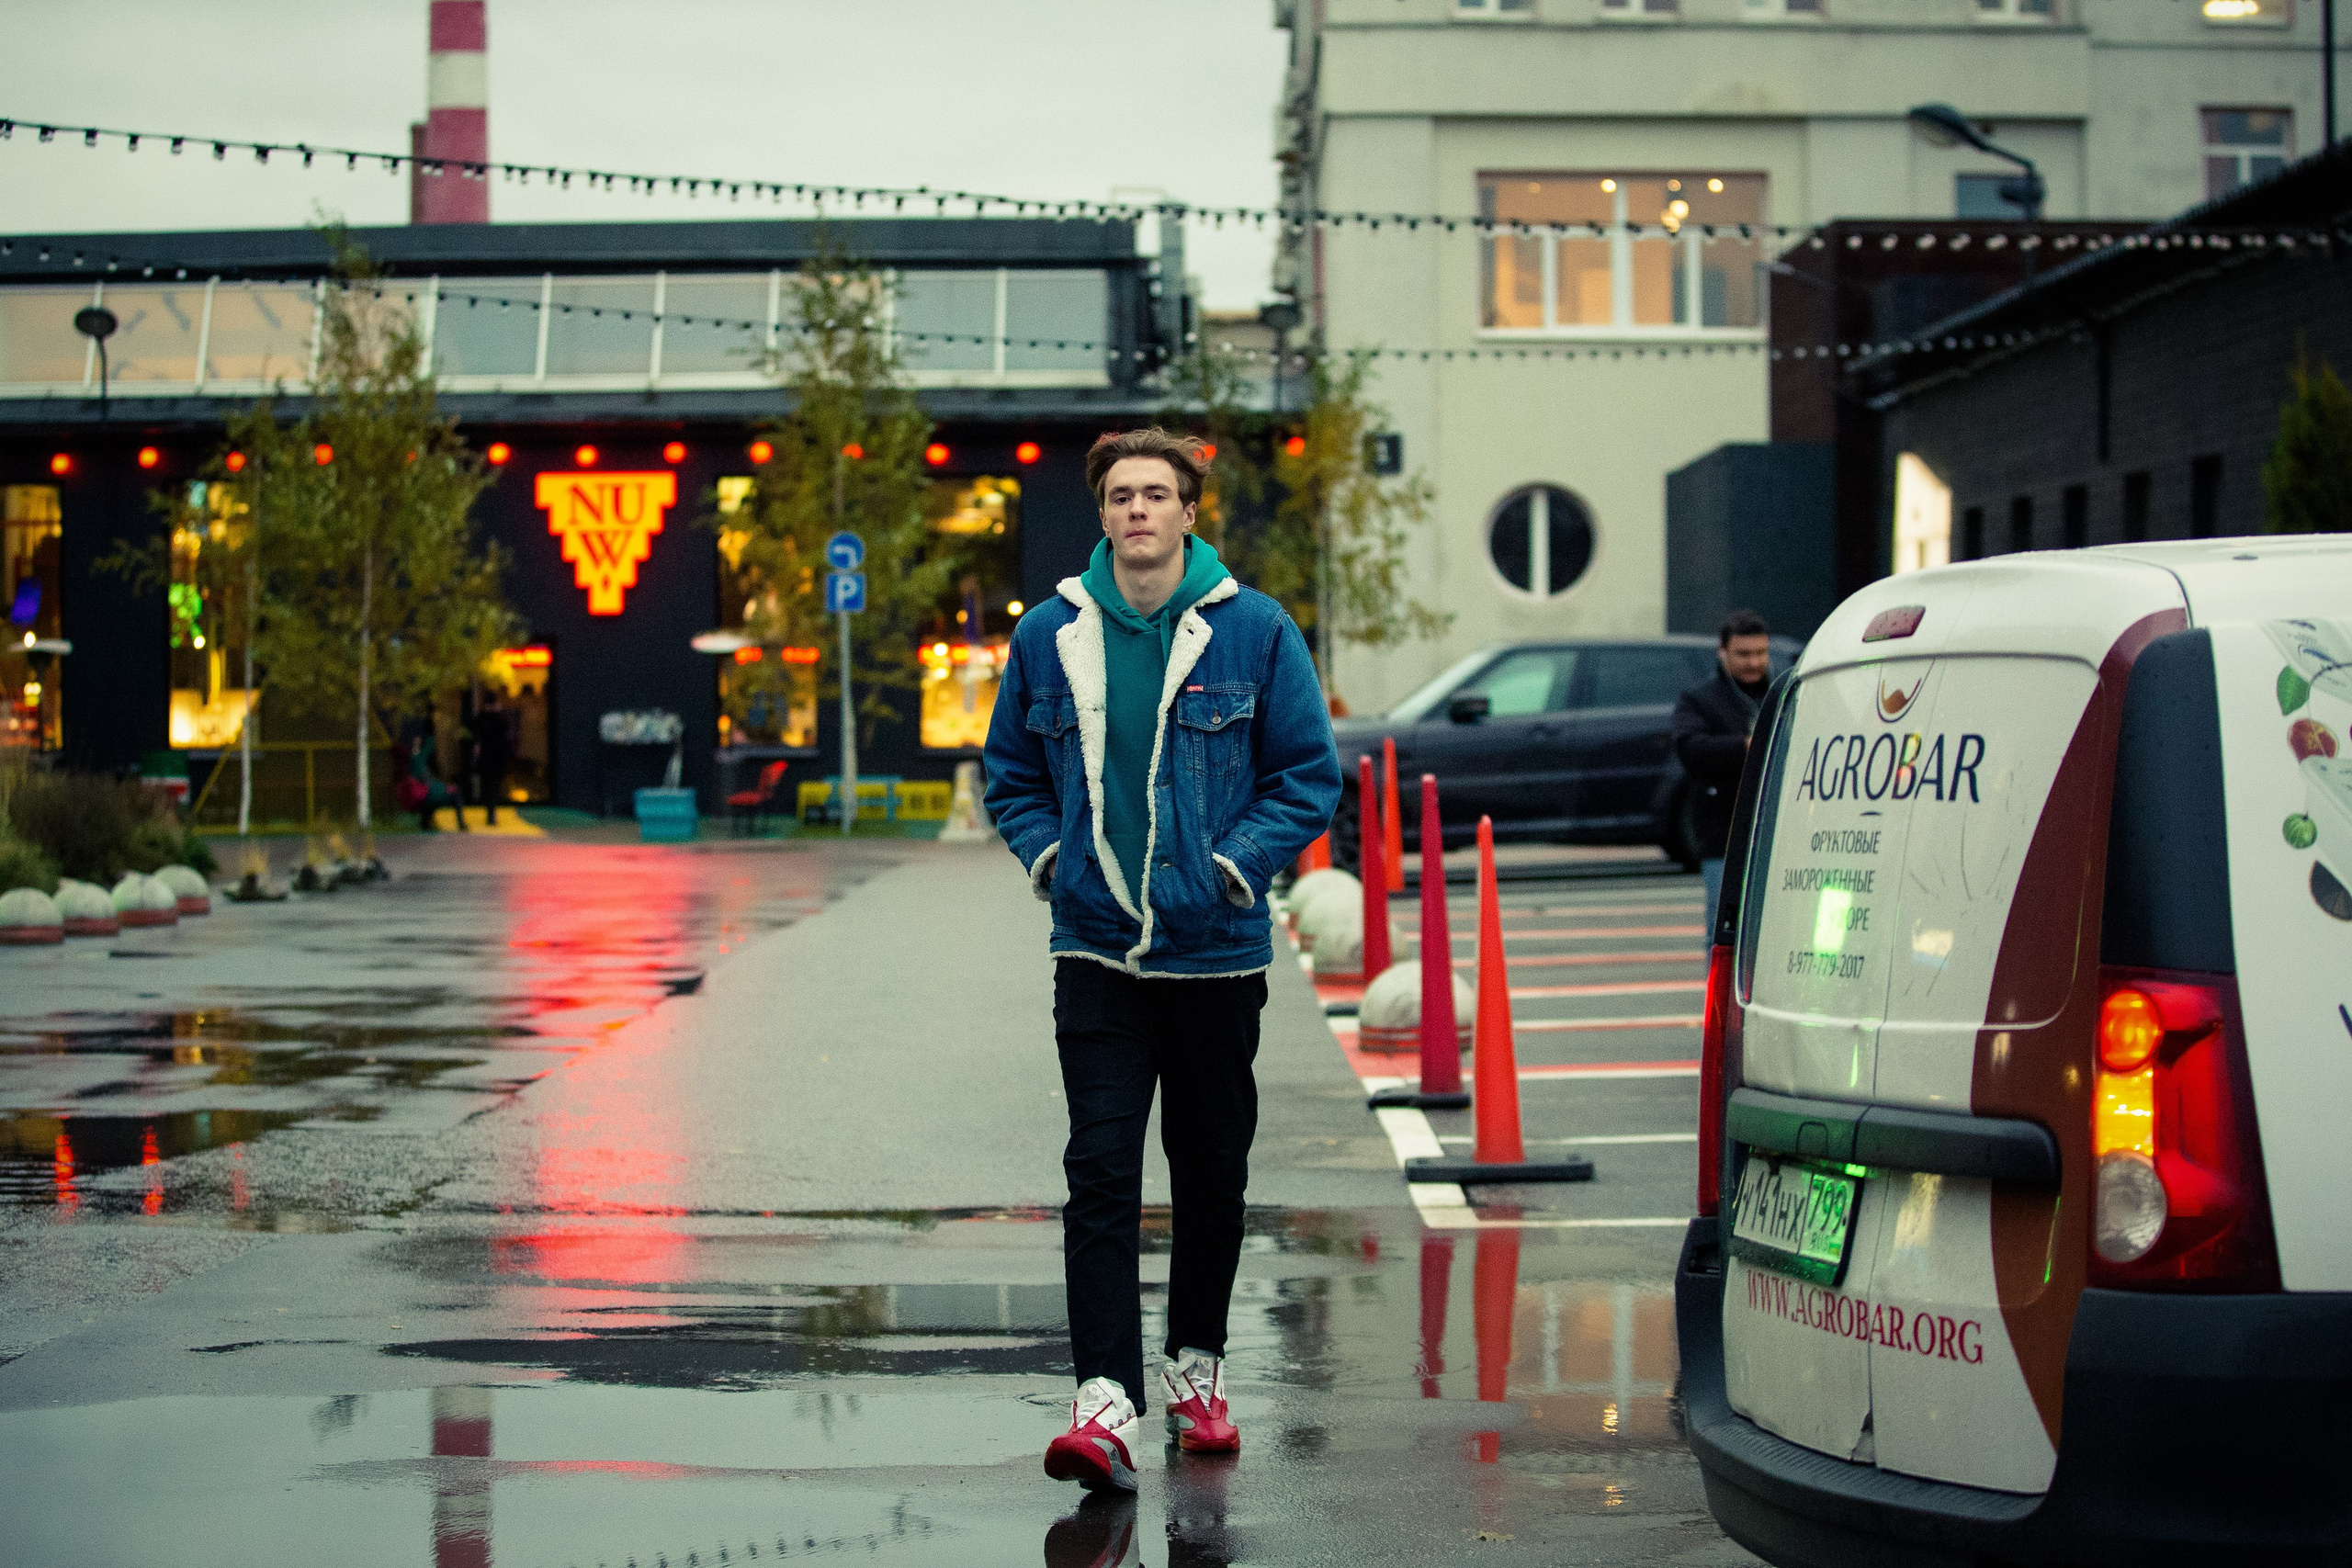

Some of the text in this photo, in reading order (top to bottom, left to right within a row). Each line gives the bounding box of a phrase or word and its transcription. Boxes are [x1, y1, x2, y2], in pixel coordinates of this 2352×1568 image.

[568, 482, 647, 525] NU
[835, 575, 857, 609] P
[1796, 732, 1985, 804] AGROBAR
[1811, 829, 1882, 854] ФРУКТОВЫЕ
[1782, 867, 1876, 893] ЗАМОРОЖЕННЫЕ
[1787, 950, 1865, 979] 8-977-779-2017
[1747, 1269, 1984, 1365] WWW.AGROBAR.ORG
